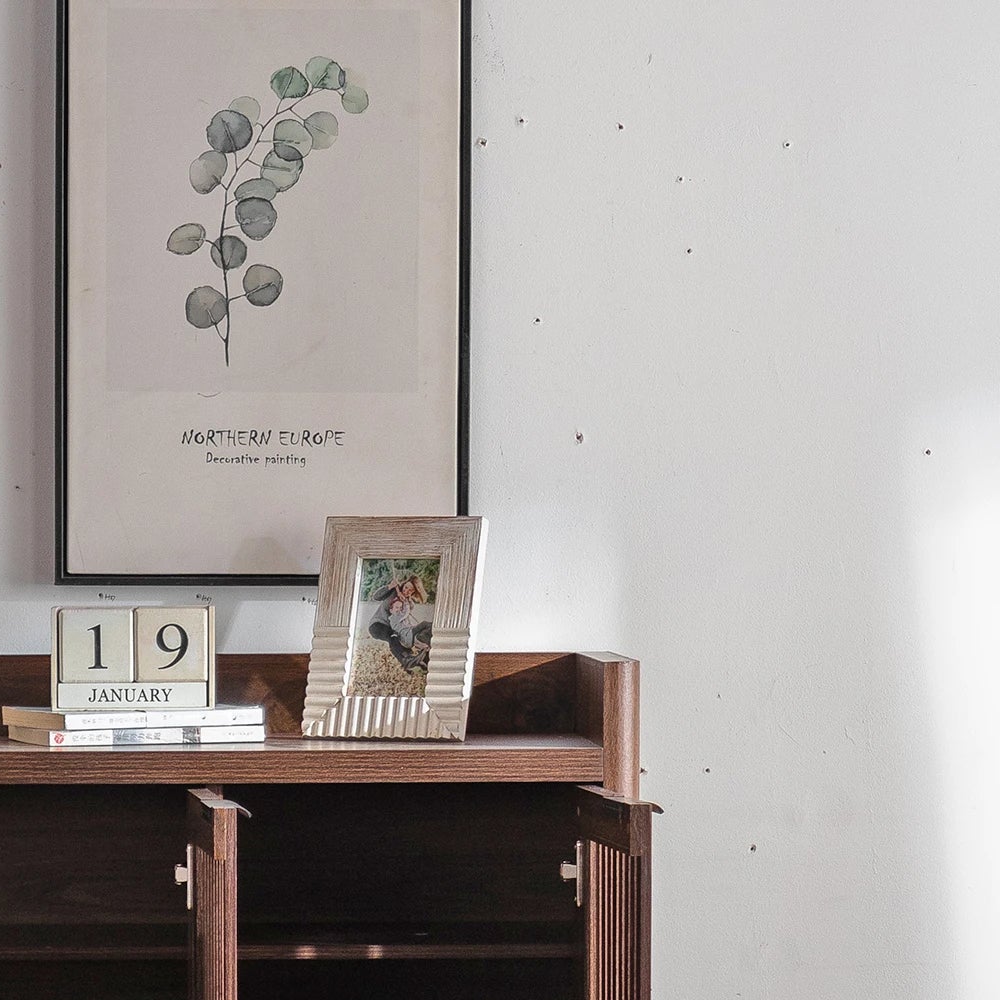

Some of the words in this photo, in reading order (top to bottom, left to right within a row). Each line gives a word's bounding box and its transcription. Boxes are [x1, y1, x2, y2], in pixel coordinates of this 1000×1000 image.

[181, 429, 272, 447] NORTHERN
[279, 430, 346, 447] EUROPE
[206, 452, 260, 465] Decorative
[265, 453, 306, 468] painting
[156, 623, 189, 670] 9
[88, 688, 173, 703] JANUARY
